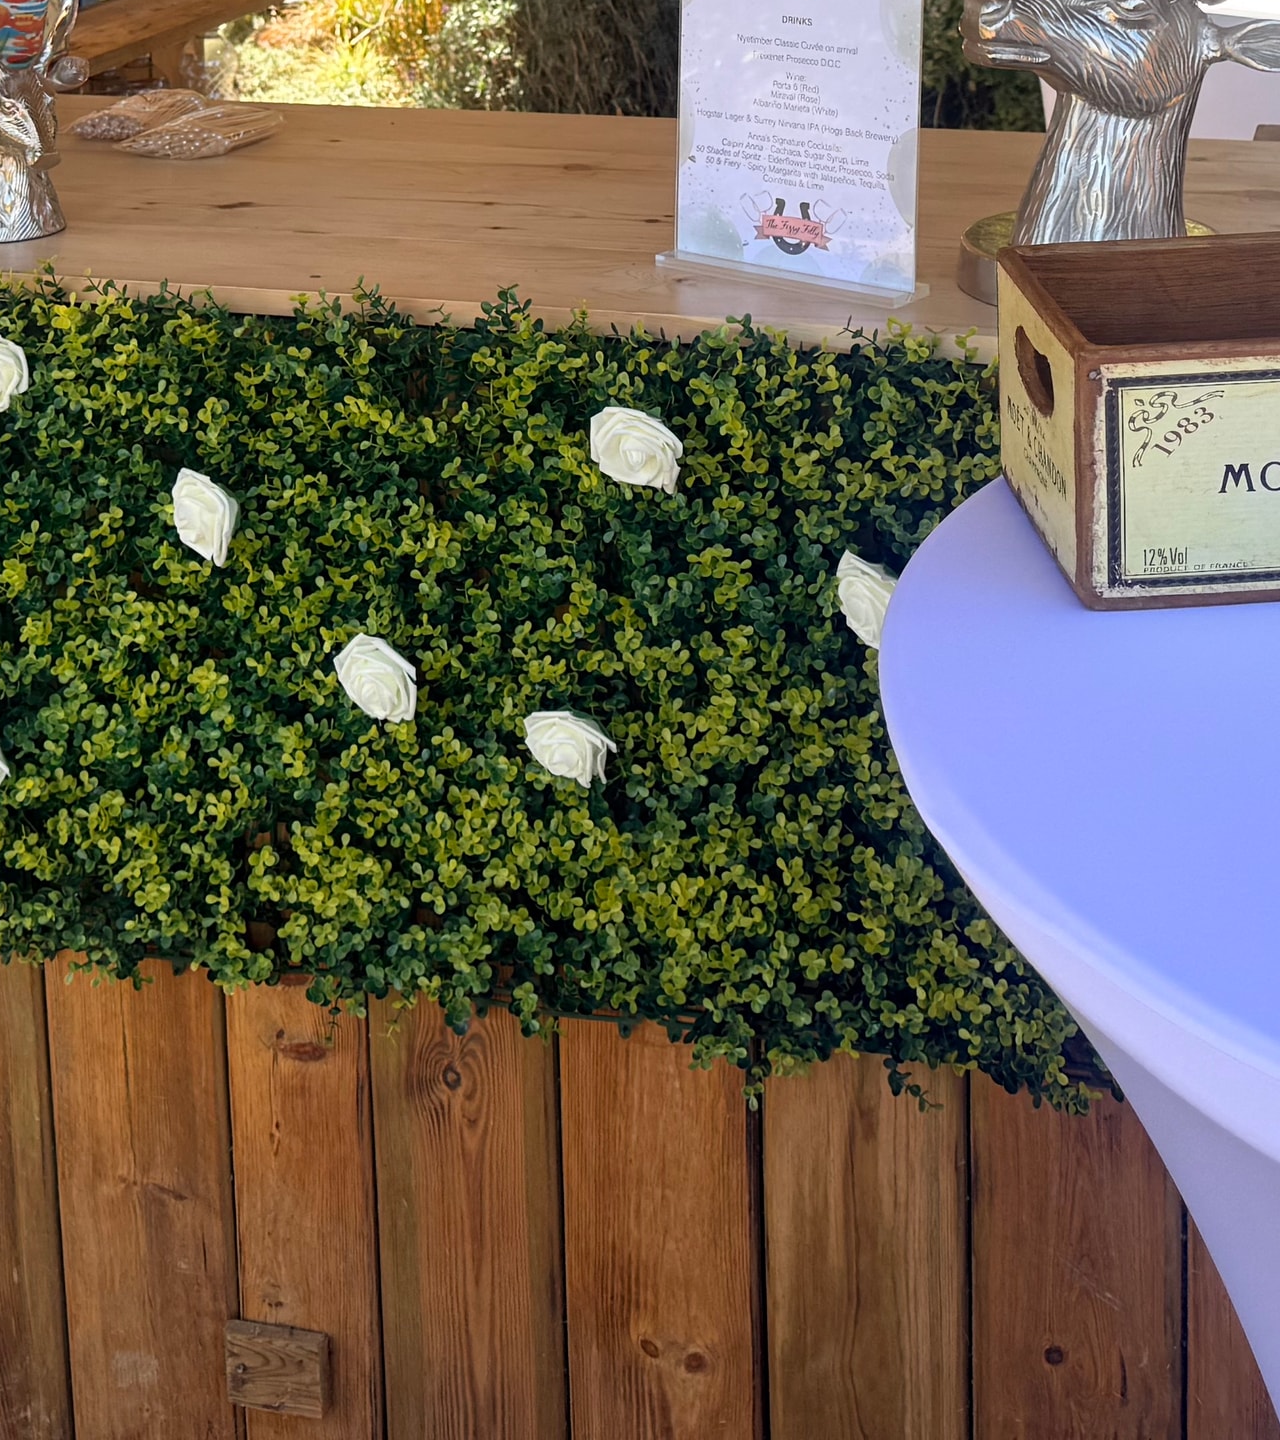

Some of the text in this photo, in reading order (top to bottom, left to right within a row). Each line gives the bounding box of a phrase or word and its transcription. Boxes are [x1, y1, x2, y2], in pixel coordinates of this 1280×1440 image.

[781, 15, 813, 27] DRINKS
[774, 38, 800, 49] Classic
[786, 54, 819, 66] Prosecco
[724, 112, 745, 123] Lager
[753, 115, 776, 128] Surrey
[807, 122, 820, 132] IPA
[845, 127, 864, 139] Back
[865, 130, 899, 145] Brewery)
[765, 218, 779, 230] The
[1150, 405, 1215, 458] 1983
[1033, 436, 1067, 502] CHANDON
[1169, 546, 1188, 565] Vol
